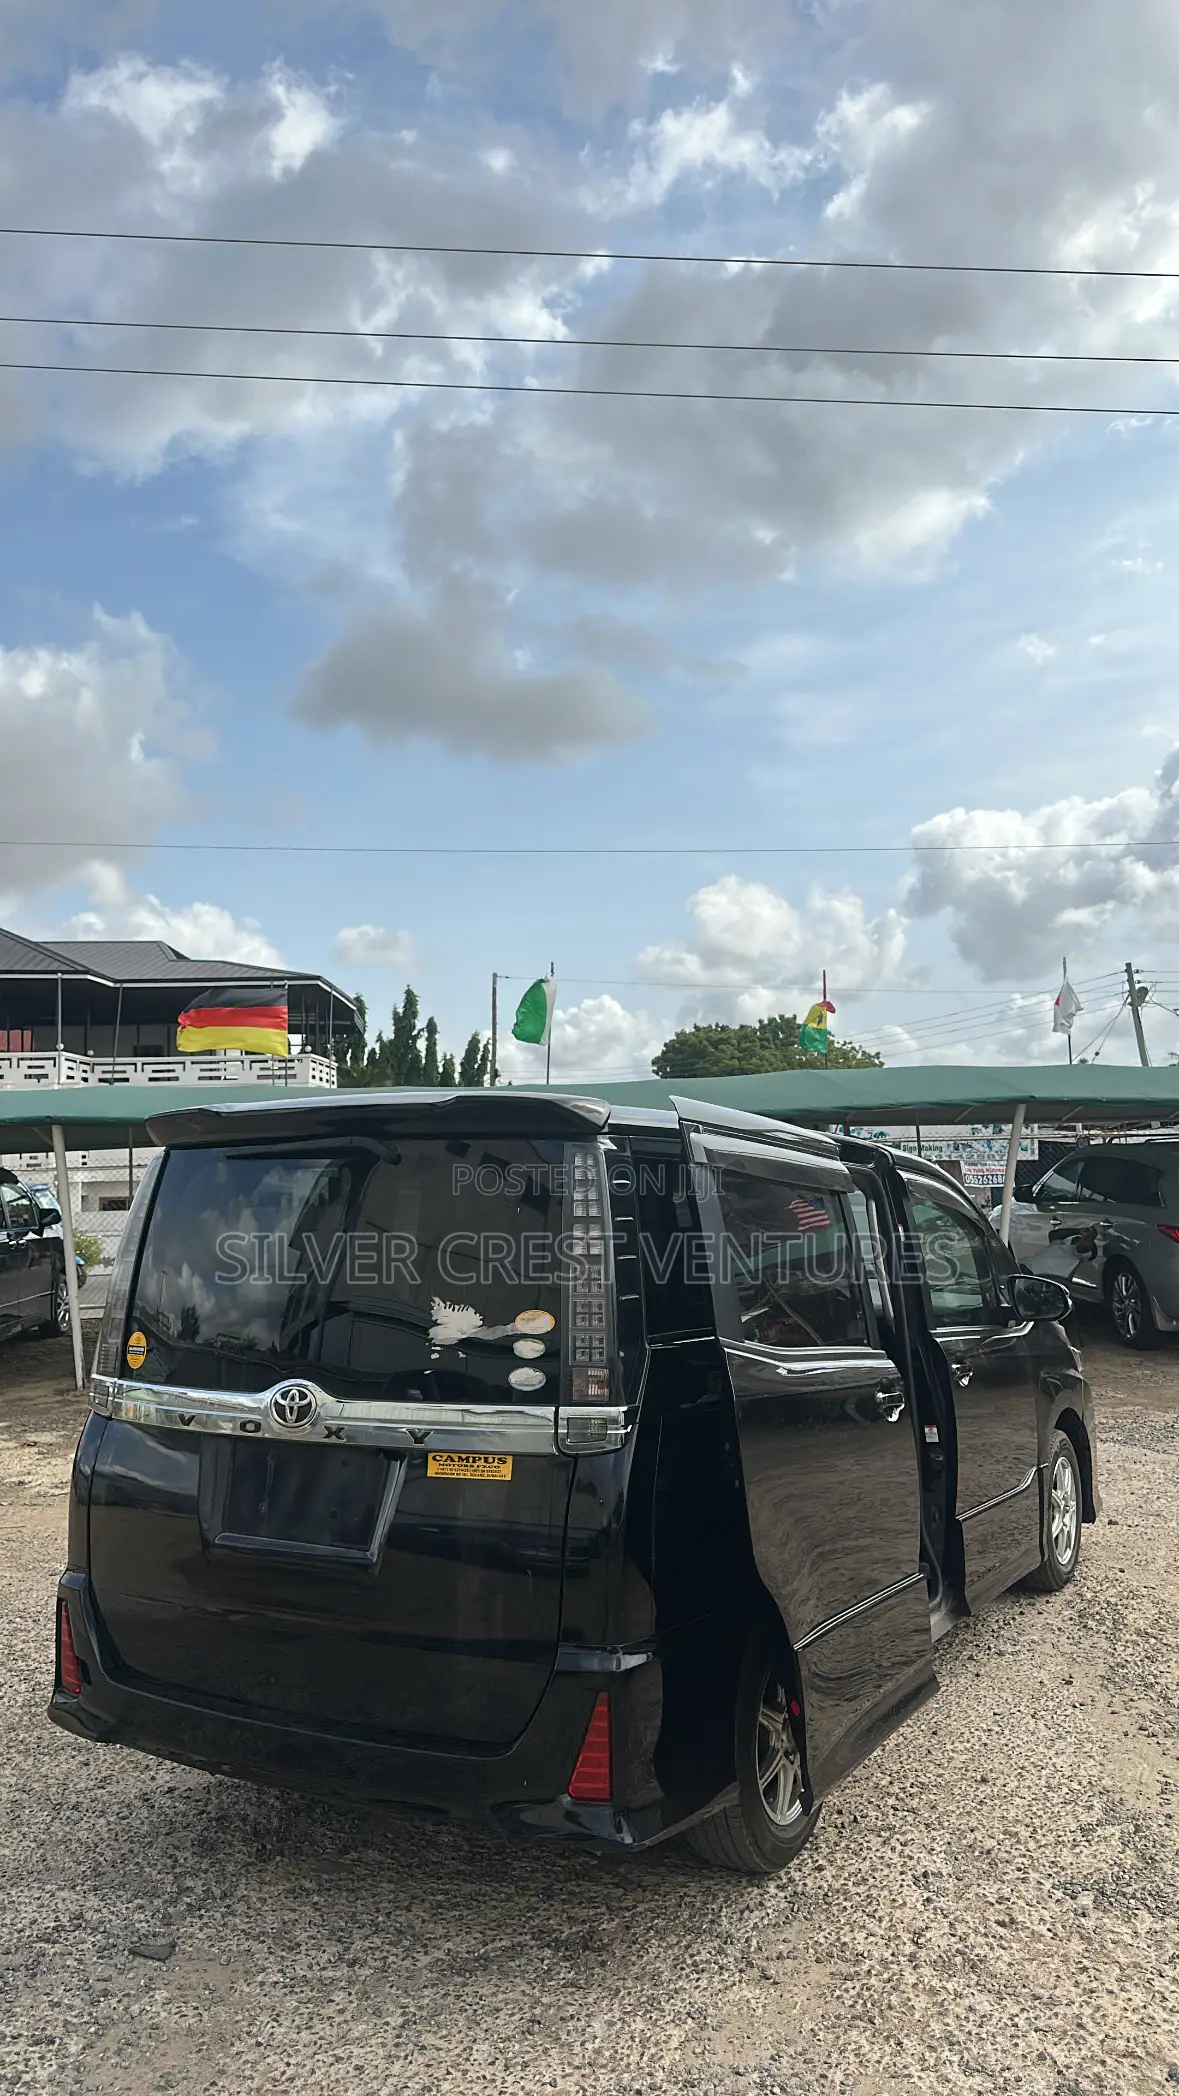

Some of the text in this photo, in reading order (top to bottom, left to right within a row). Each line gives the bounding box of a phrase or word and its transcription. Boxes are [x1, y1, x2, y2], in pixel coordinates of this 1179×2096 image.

[902, 1144, 917, 1153] Sign
[178, 1413, 434, 1446] VOXY
[431, 1454, 508, 1465] CAMPUS
